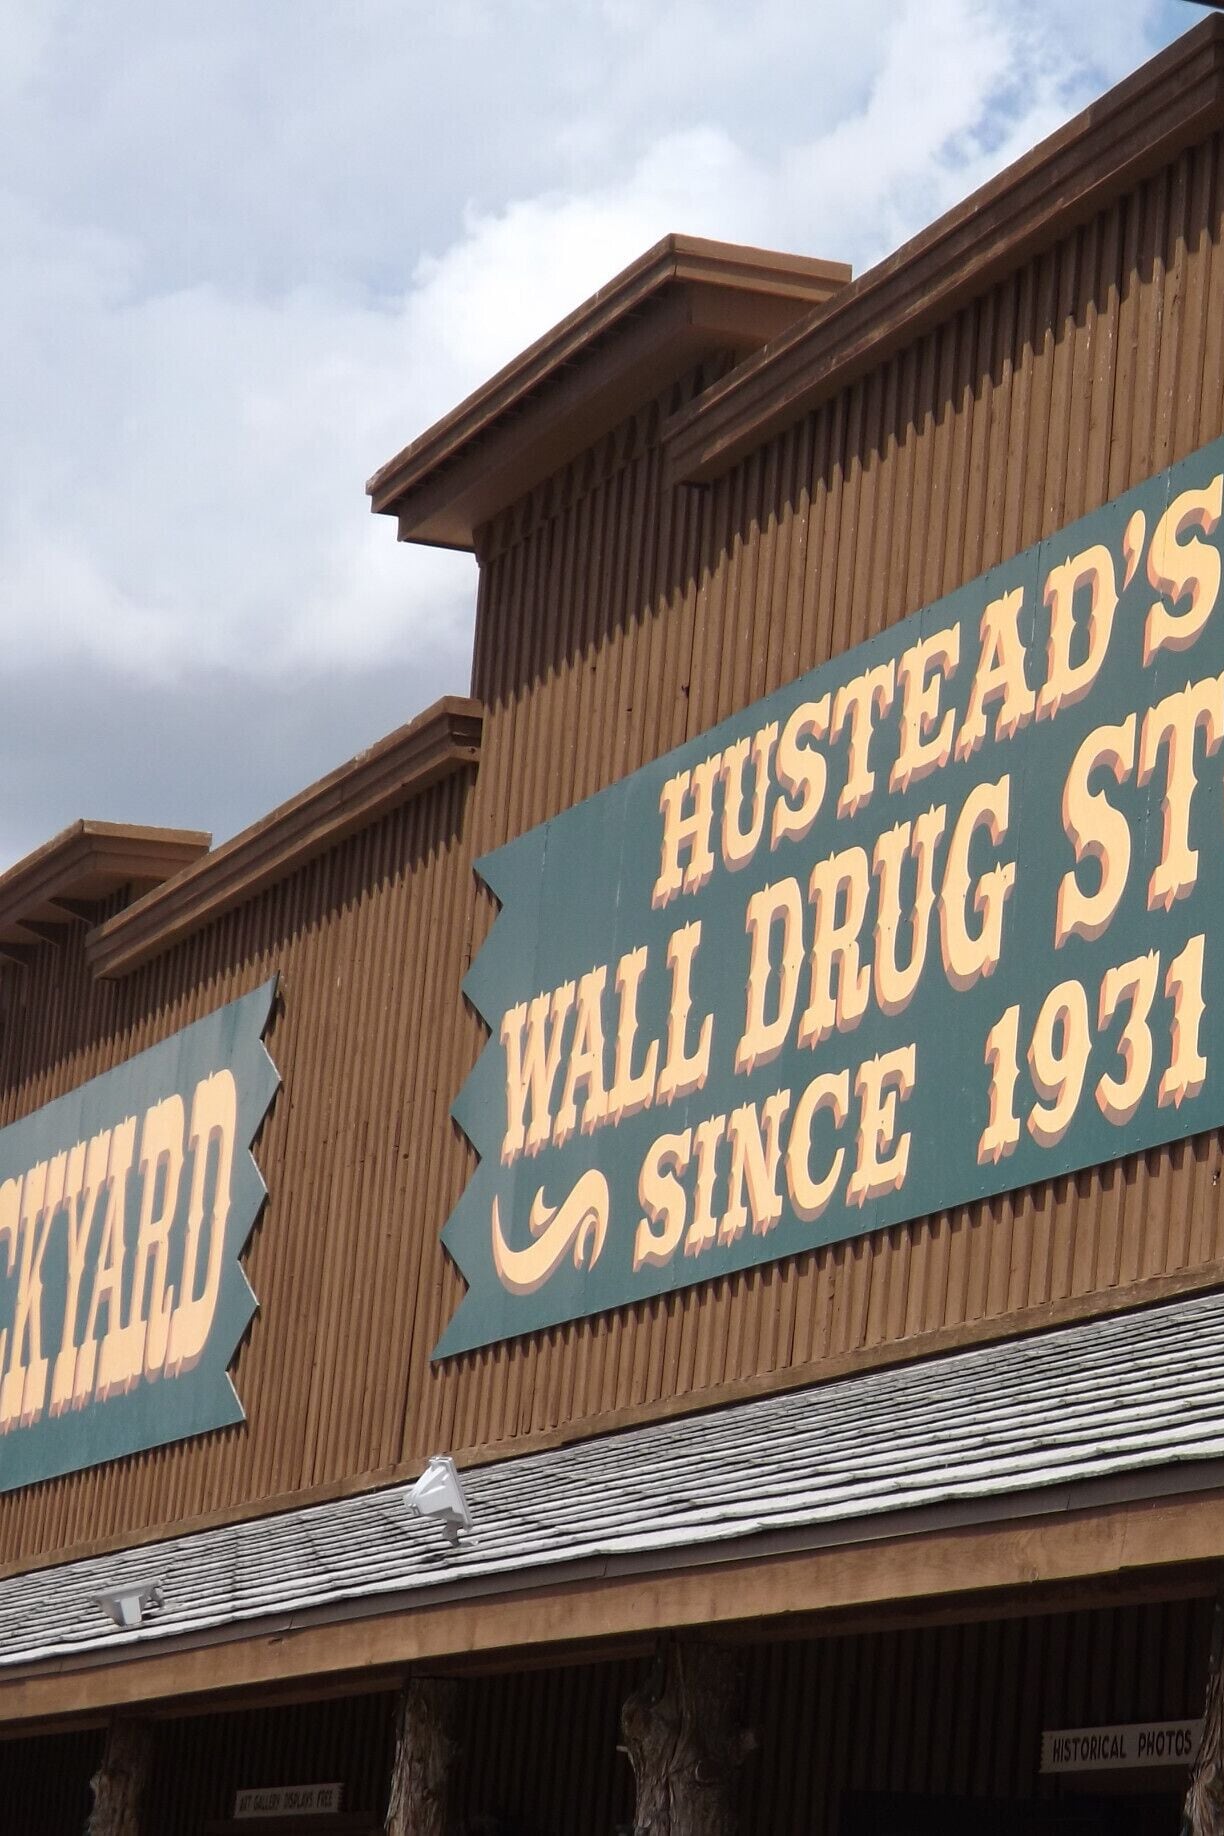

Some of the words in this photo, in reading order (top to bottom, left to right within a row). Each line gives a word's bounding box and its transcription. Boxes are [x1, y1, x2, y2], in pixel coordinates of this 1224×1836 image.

[652, 474, 1223, 911] HUSTEAD'S
[500, 921, 714, 1166] WALL
[735, 773, 1015, 1076] DRUG
[633, 1044, 916, 1271] SINCE
[977, 933, 1207, 1164] 1931
[1053, 1735, 1126, 1762] HISTORICAL
[1138, 1728, 1192, 1757] PHOTOS
